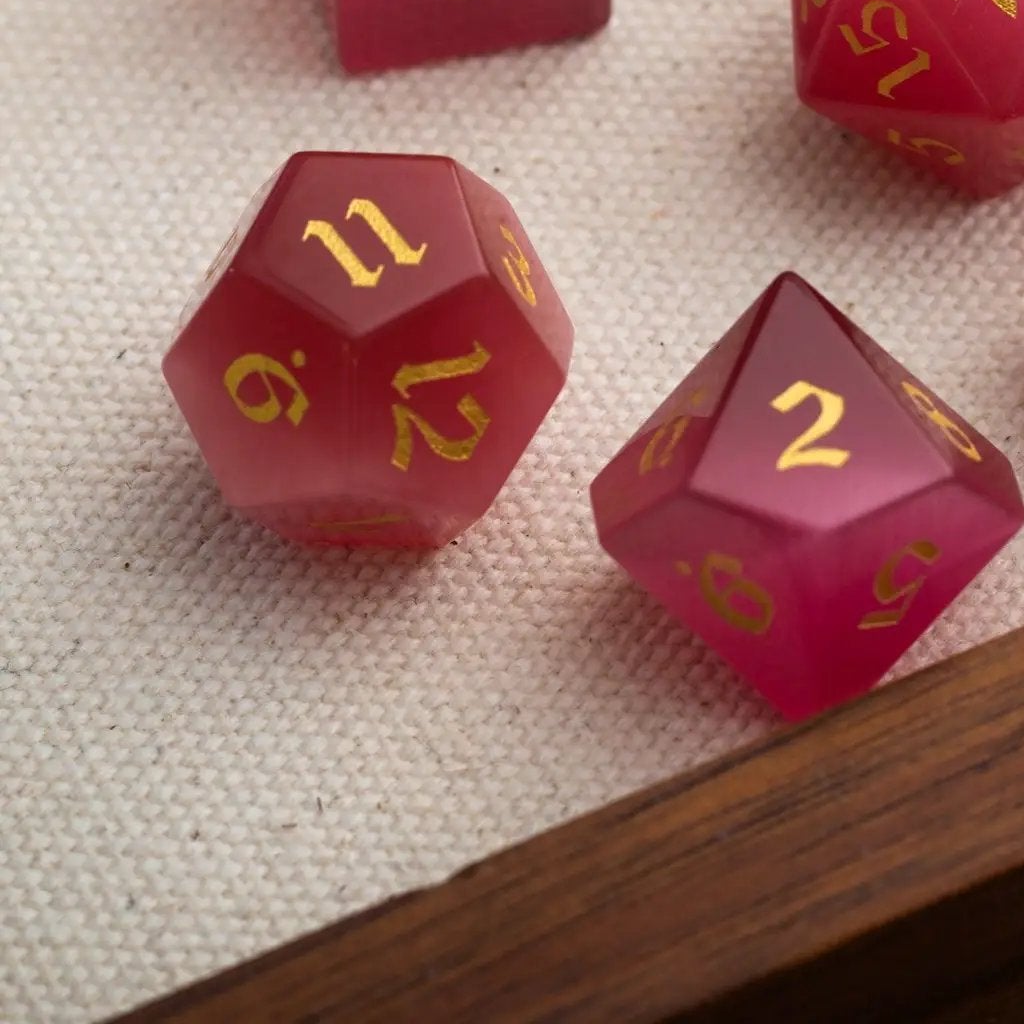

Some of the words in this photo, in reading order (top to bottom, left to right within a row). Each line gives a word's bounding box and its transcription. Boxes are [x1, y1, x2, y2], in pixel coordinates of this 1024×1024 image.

[838, 0, 931, 101] 15
[302, 198, 428, 288] 11
[390, 339, 492, 473] 12
[769, 379, 851, 472] 2
[901, 380, 983, 463] 8
[856, 538, 943, 631] 5
